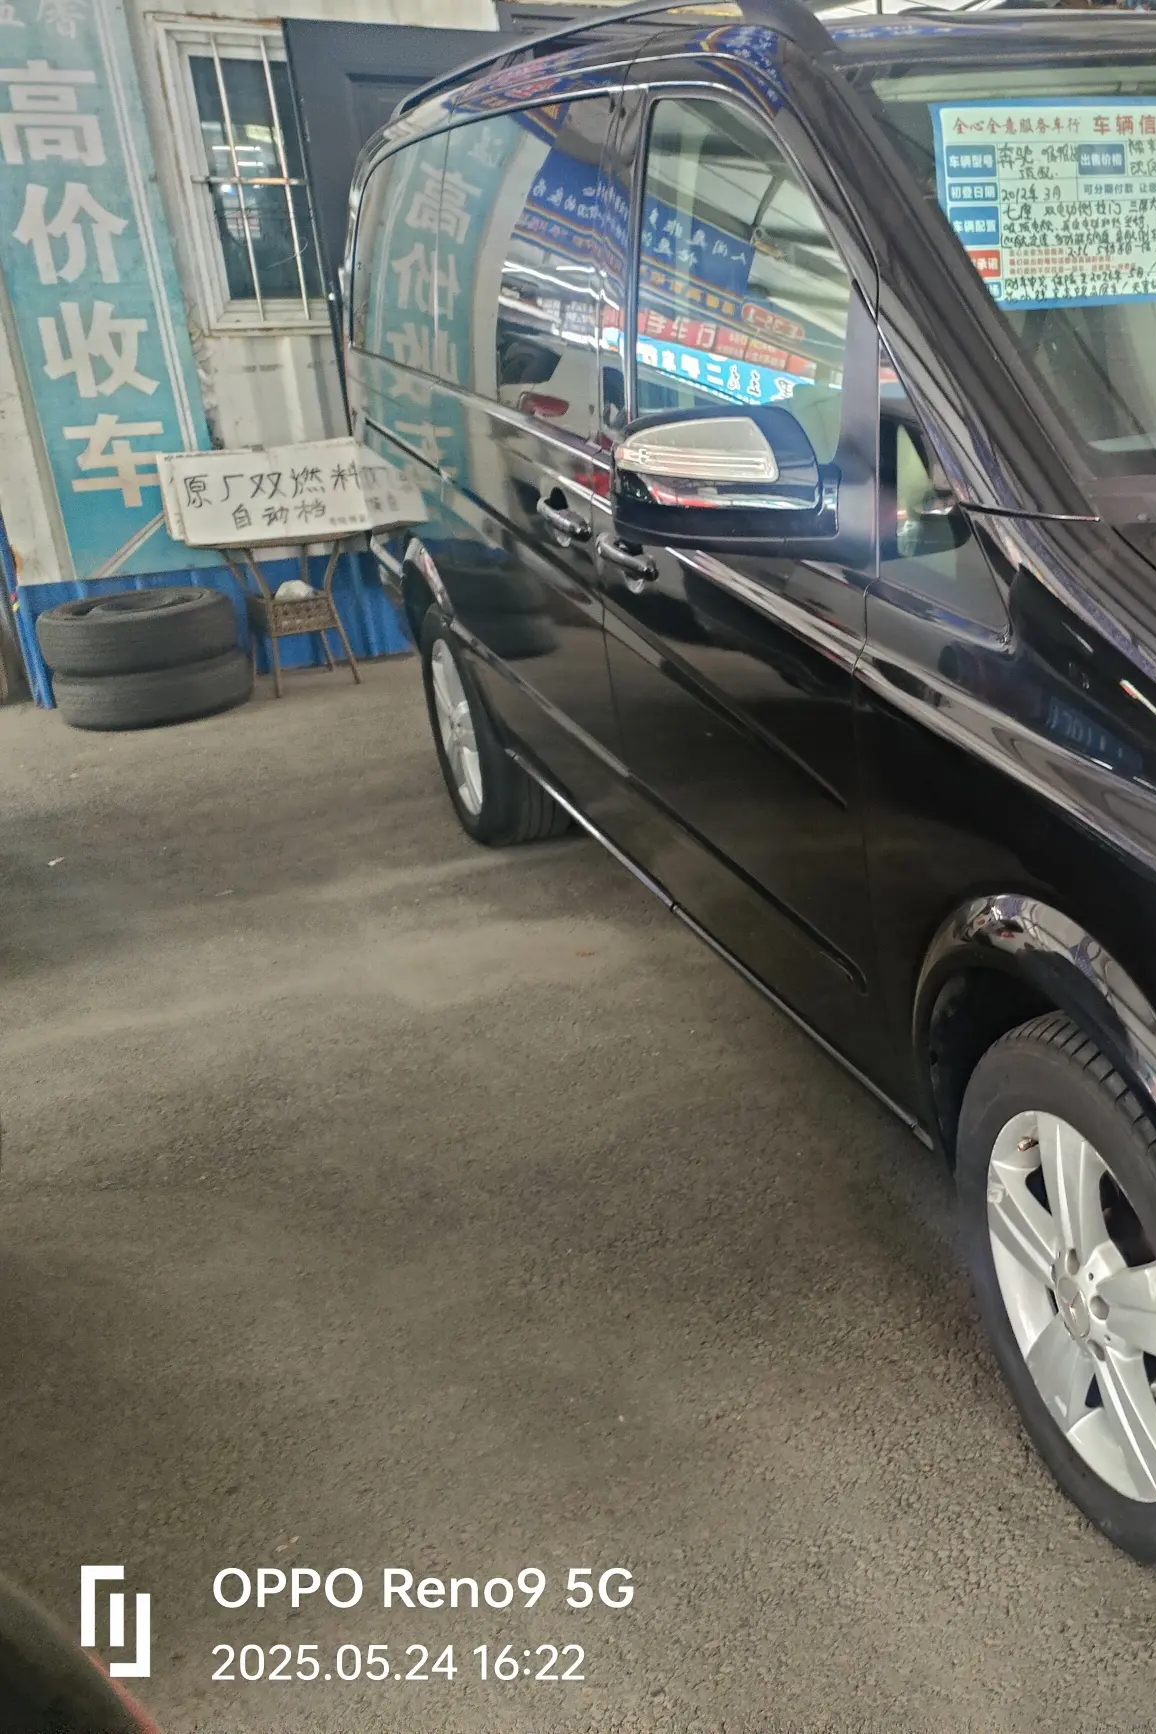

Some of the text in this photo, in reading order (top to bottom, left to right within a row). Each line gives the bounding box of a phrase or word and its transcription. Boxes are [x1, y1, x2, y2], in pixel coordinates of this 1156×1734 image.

[0, 59, 164, 508] 高价收车
[184, 460, 361, 508] 原厂双燃料
[232, 500, 326, 530] 自动档
